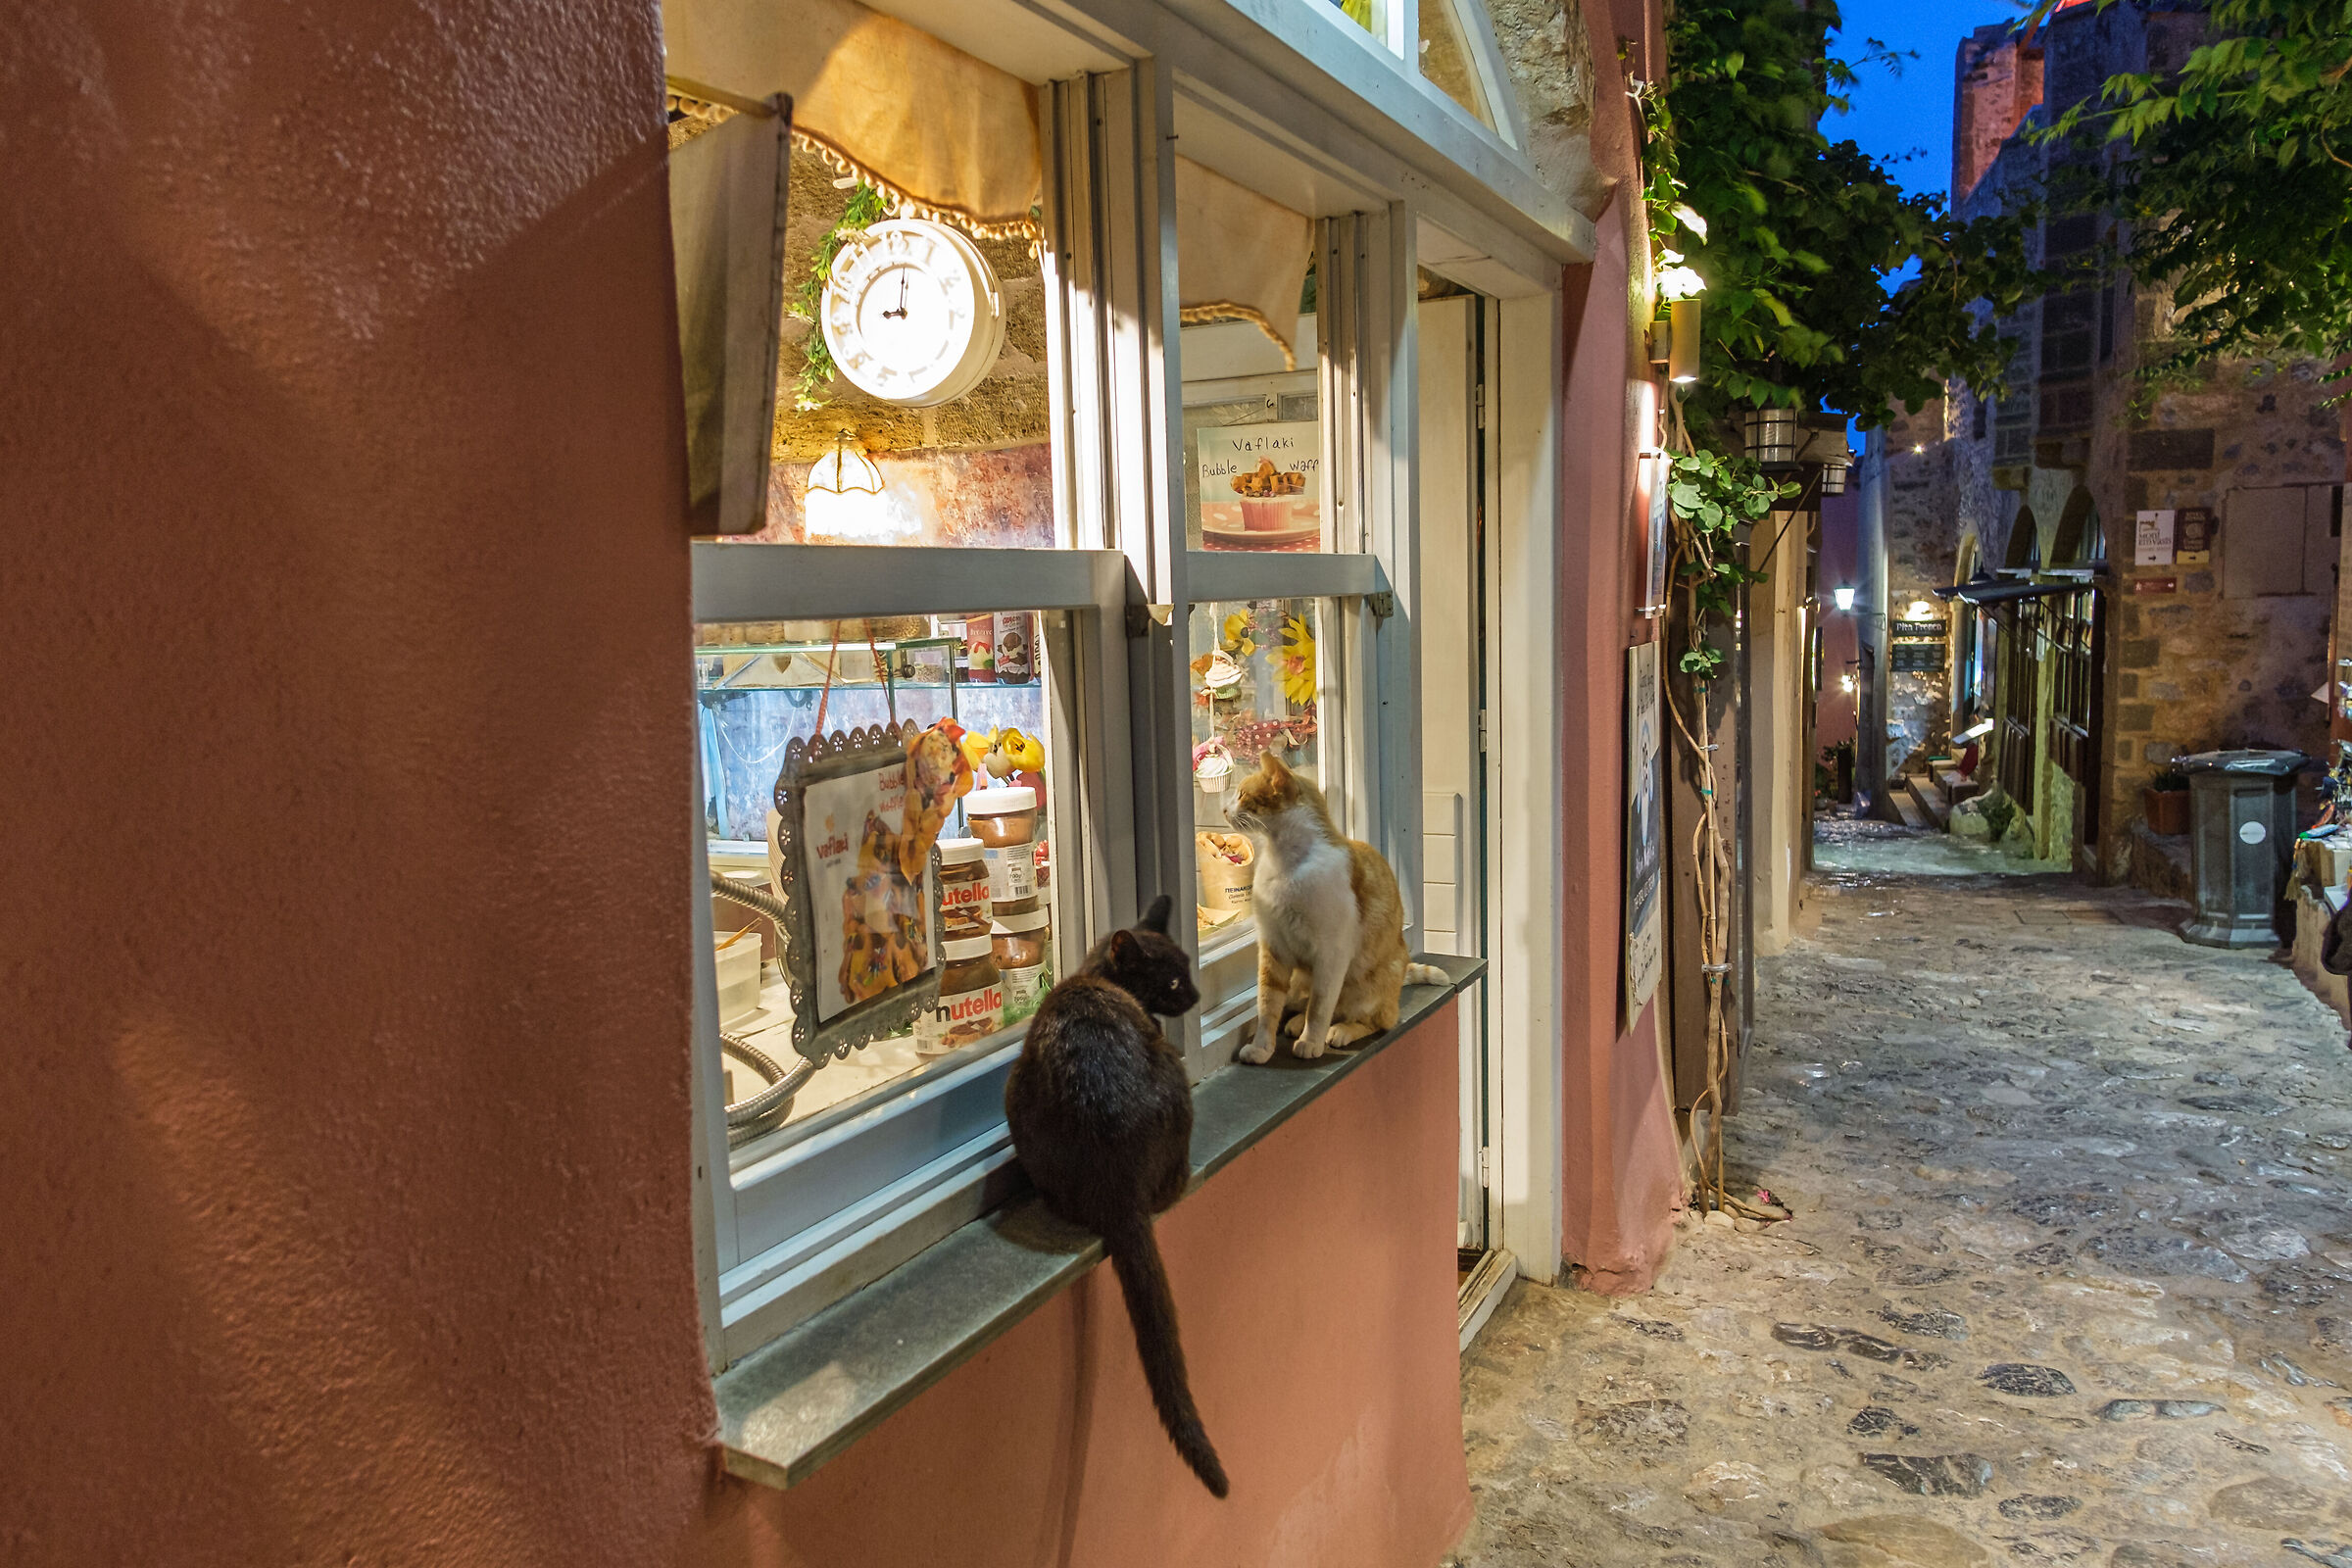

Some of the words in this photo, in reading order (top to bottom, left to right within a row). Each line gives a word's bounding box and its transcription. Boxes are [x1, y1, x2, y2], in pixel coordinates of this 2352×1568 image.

[1232, 437, 1295, 452] Vaflaki
[1201, 459, 1239, 478] Bubble
[942, 882, 990, 906] utella
[936, 988, 1003, 1023] nutella
